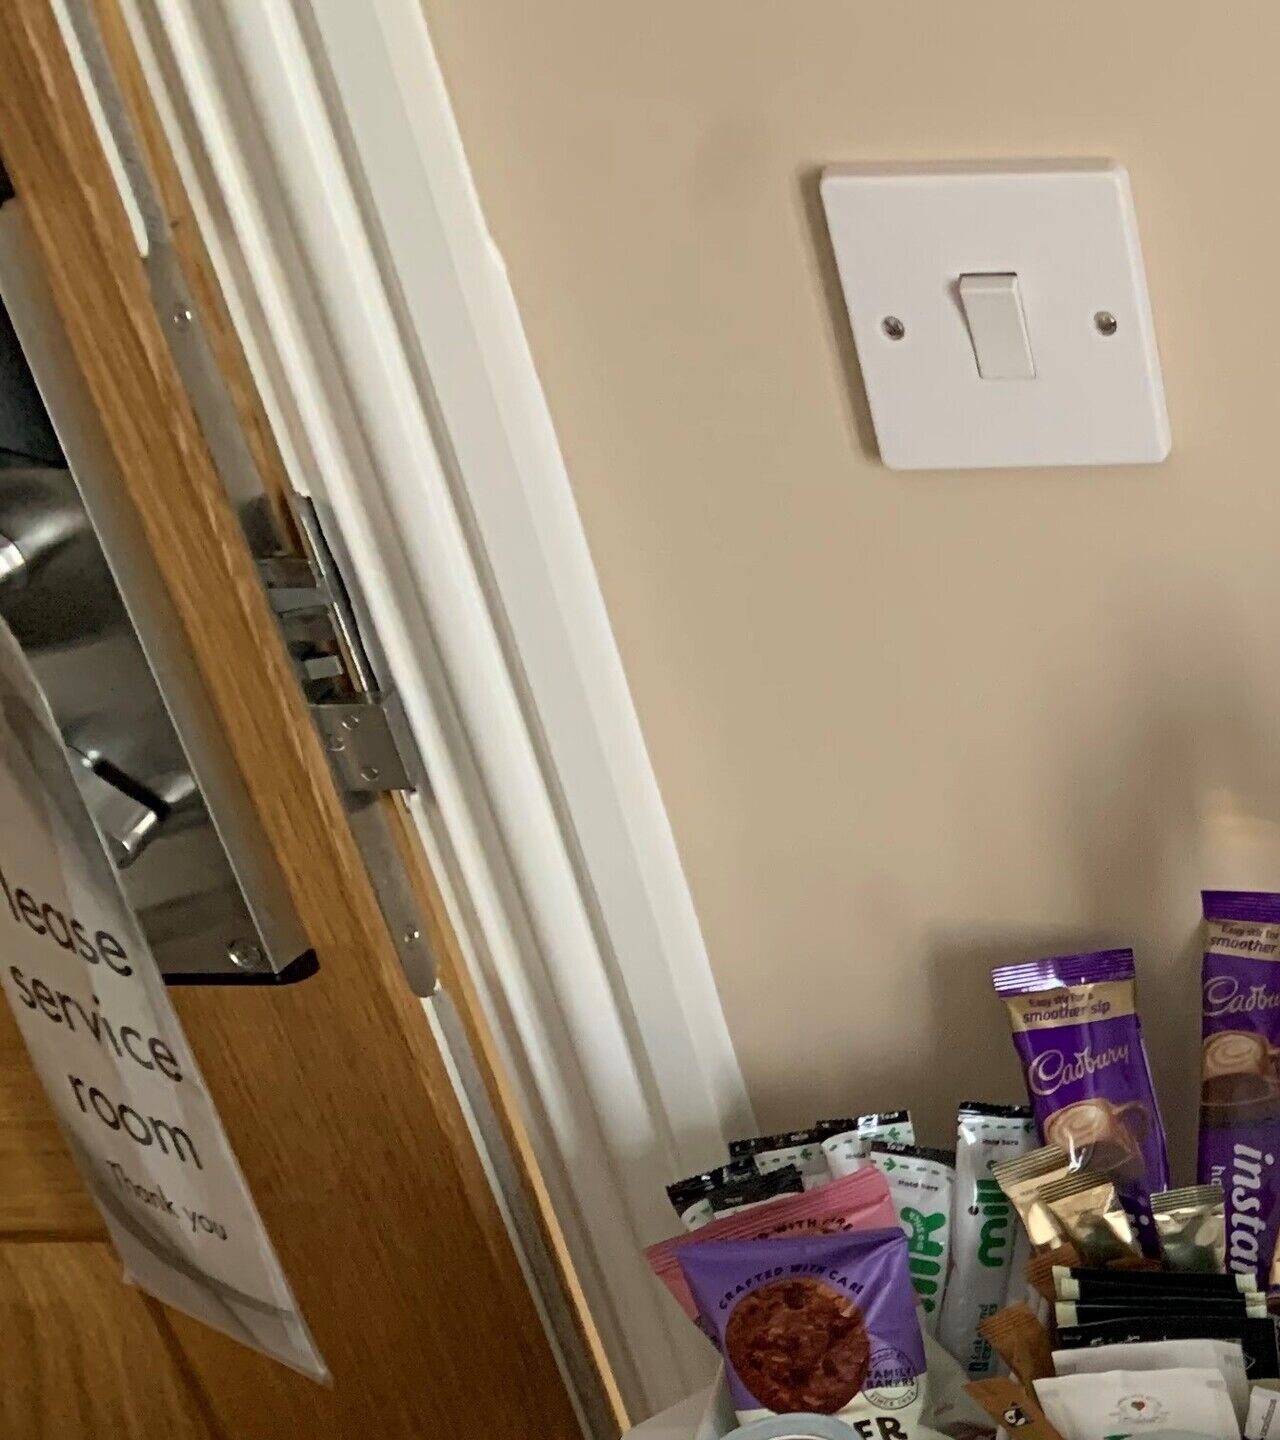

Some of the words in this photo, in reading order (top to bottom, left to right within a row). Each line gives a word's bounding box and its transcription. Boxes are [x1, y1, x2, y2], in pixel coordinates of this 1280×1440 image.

[0, 870, 132, 977] lease
[1210, 936, 1277, 954] smoother
[9, 964, 182, 1082] service
[1023, 1004, 1087, 1024] smoother
[1090, 1000, 1112, 1017] sip
[1028, 1045, 1130, 1096] Cadbury
[68, 1073, 203, 1170] room
[182, 1207, 229, 1242] you
[718, 1266, 784, 1310] CRAFTED
[789, 1263, 828, 1275] WITH
